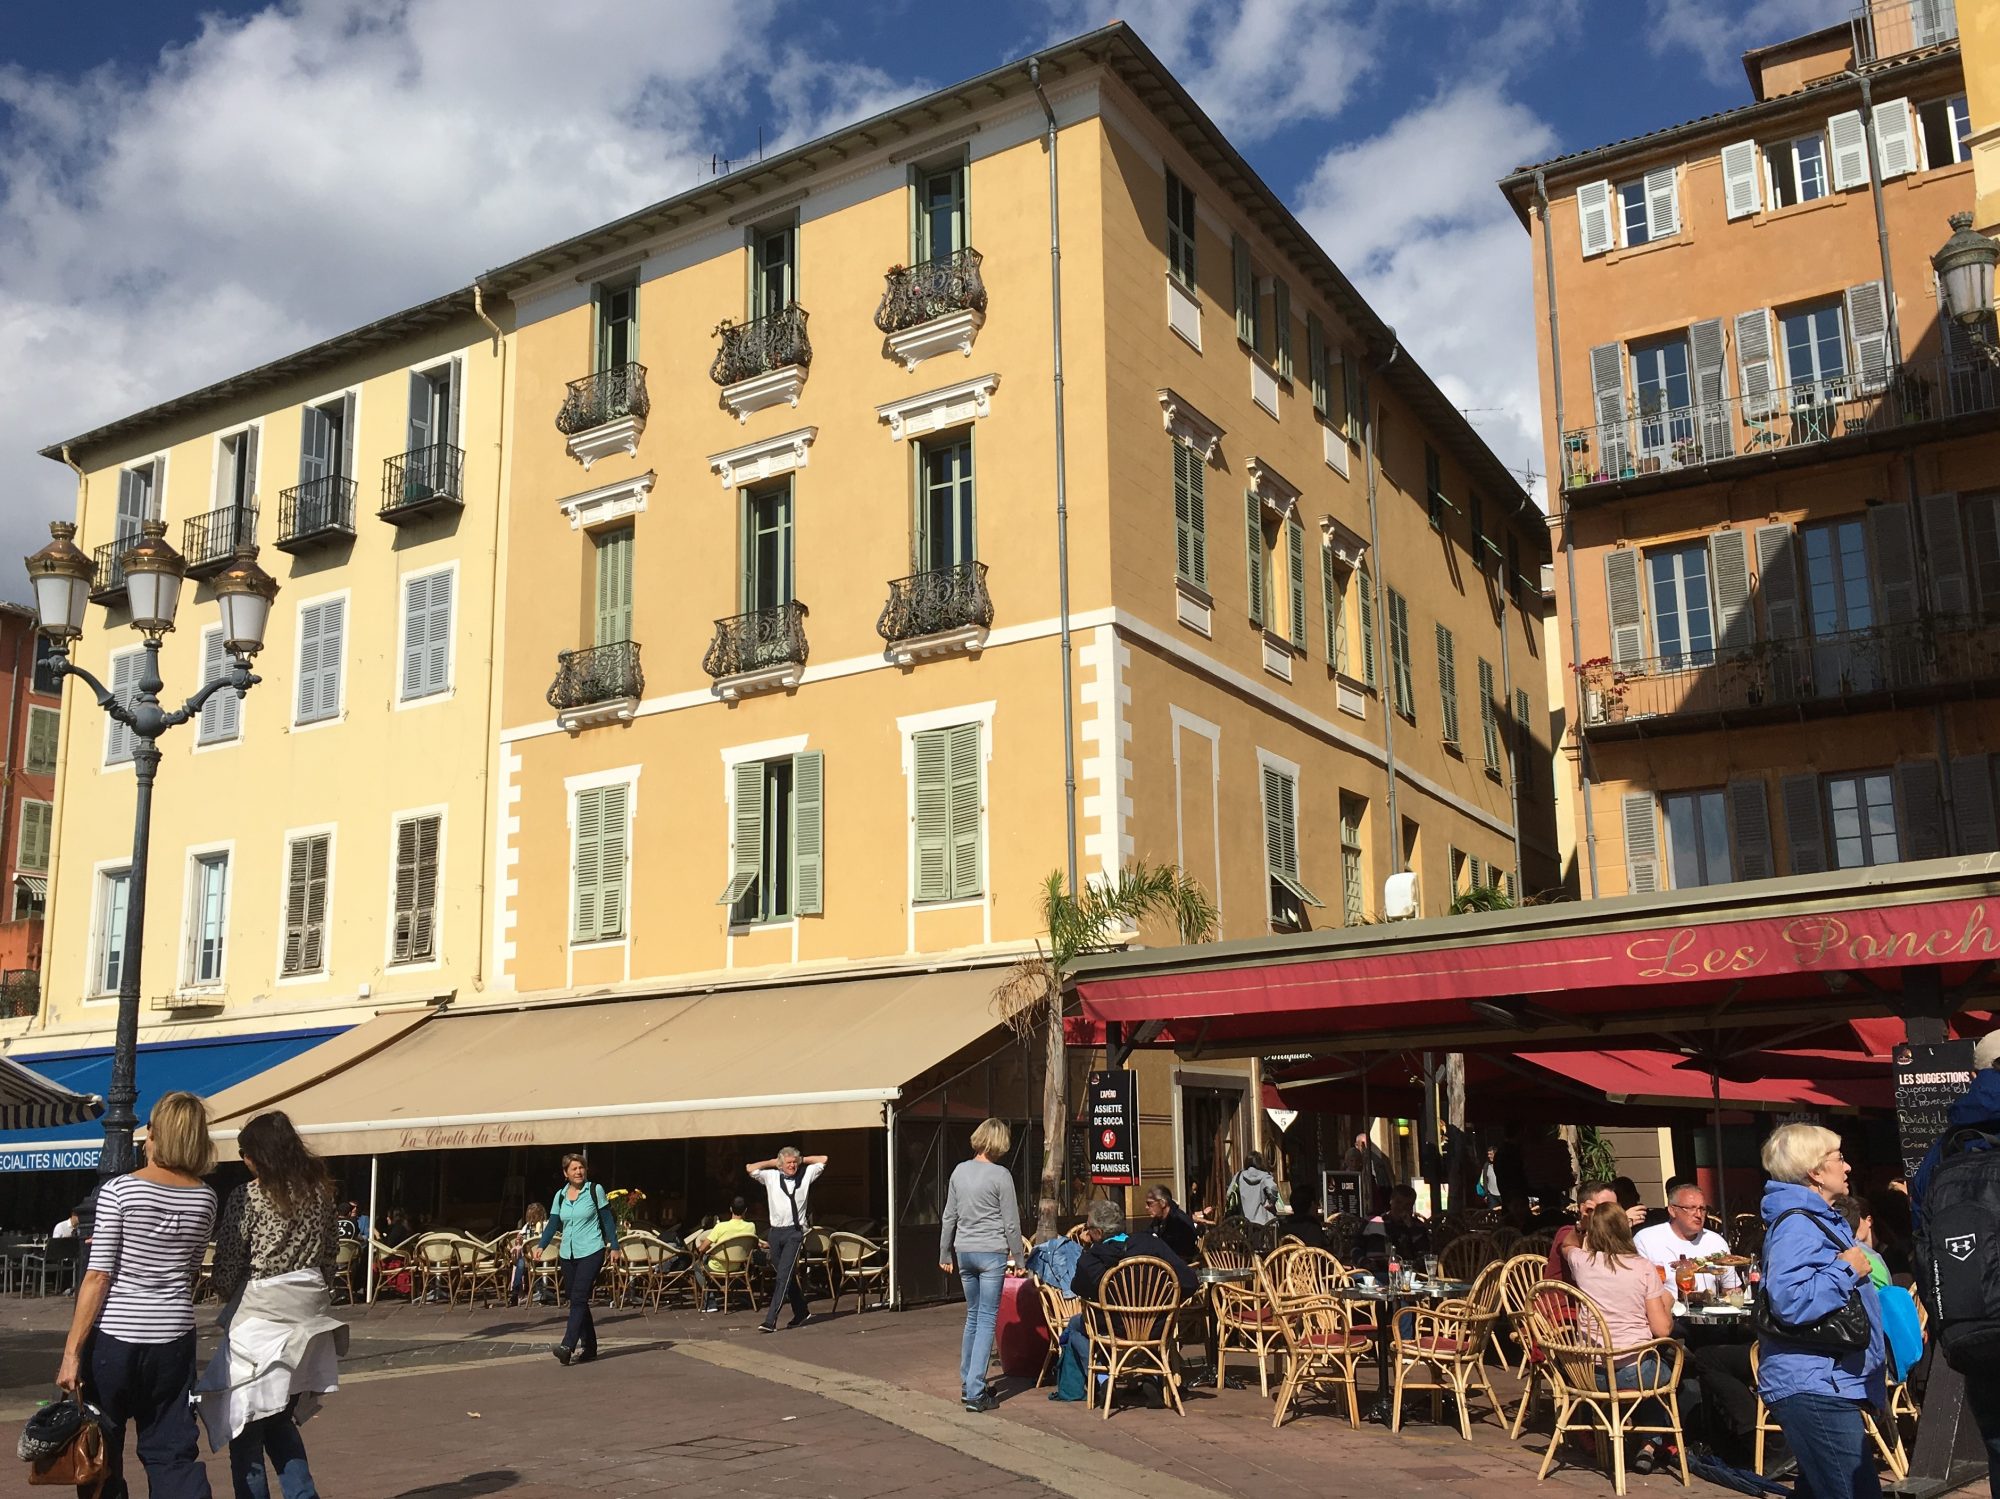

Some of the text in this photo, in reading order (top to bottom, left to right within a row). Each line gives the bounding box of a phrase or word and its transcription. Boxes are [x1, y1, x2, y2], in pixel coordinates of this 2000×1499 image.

[1626, 903, 2000, 978] Les Ponch
[1899, 1071, 1970, 1085] LES SUGGESTIONS
[1094, 1104, 1122, 1113] ASSIETTE
[1093, 1117, 1124, 1125] DE SOCCA
[1280, 1117, 1287, 1126] 5
[400, 1128, 417, 1148] La
[471, 1125, 489, 1145] du
[497, 1123, 535, 1143] Cours
[52, 1151, 102, 1168] NICOISE
[1095, 1151, 1124, 1160] ASSIETTE
[1091, 1163, 1130, 1173] DE PANISSES
